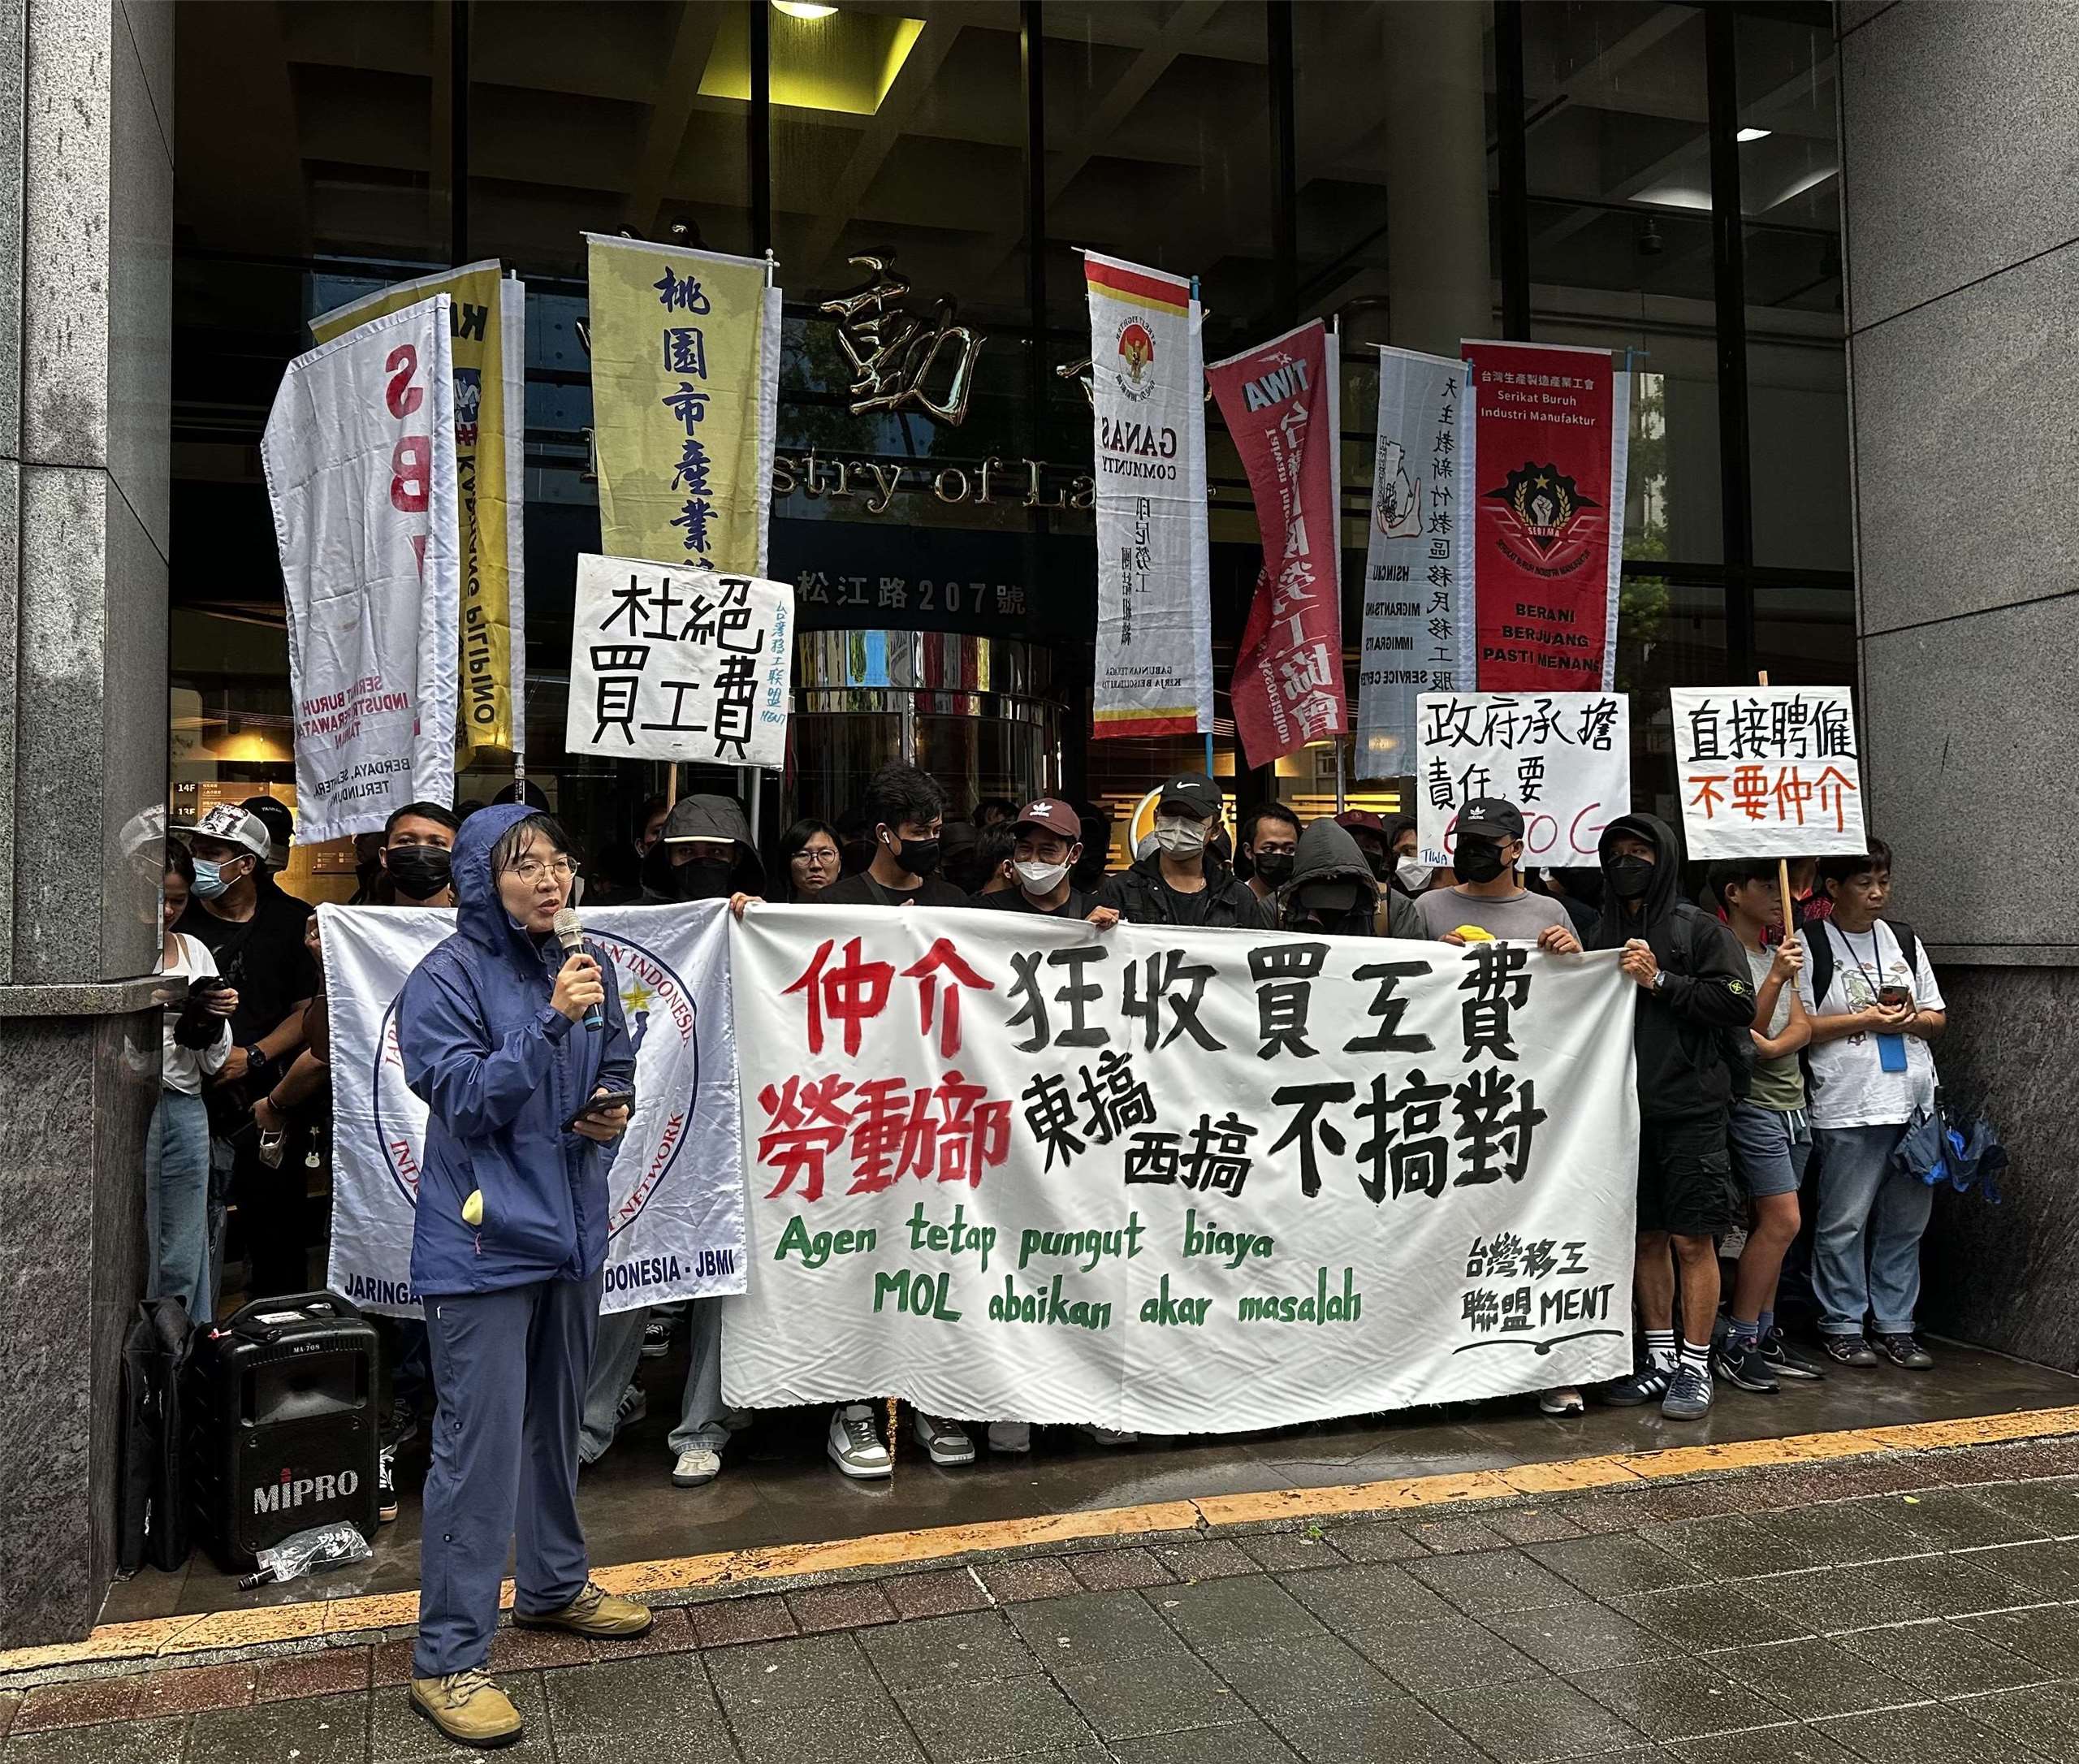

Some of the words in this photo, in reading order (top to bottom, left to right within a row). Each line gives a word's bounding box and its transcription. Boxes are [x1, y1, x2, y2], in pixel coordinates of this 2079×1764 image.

[653, 266, 720, 569] 桃園市產業
[1480, 407, 1527, 421] Industri
[1529, 411, 1596, 427] Manufaktur
[1497, 390, 1539, 404] Serikat
[1542, 392, 1577, 407] Buruh
[934, 458, 1005, 506] of
[599, 574, 764, 655] 杜絕
[1502, 625, 1589, 647] BERJUANG
[1515, 603, 1575, 624] BERANI
[1483, 647, 1534, 664] PASTI
[590, 645, 759, 760] 買工費
[1424, 696, 1619, 751] 政府承擔
[1688, 693, 1858, 763] 直接聘僱
[178, 783, 196, 793] 14F
[1688, 765, 1857, 833] 不要仲介
[1421, 848, 1448, 865] TIWA
[619, 1110, 685, 1218] NETWORK
[774, 1214, 878, 1269] Agen
[906, 1201, 998, 1273] tetap
[1018, 1211, 1148, 1273] pungut
[1183, 1208, 1275, 1270] biaya
[1465, 1232, 1591, 1279] 台灣移工
[344, 1272, 423, 1306] JARINGA
[603, 1256, 681, 1293] DONESIA
[694, 1248, 735, 1278] JBMI
[873, 1269, 964, 1324] MOL
[988, 1273, 1113, 1331] abaikan
[1139, 1273, 1212, 1328] akar
[1238, 1266, 1362, 1327] masalah
[253, 1468, 359, 1515] MIPRO
